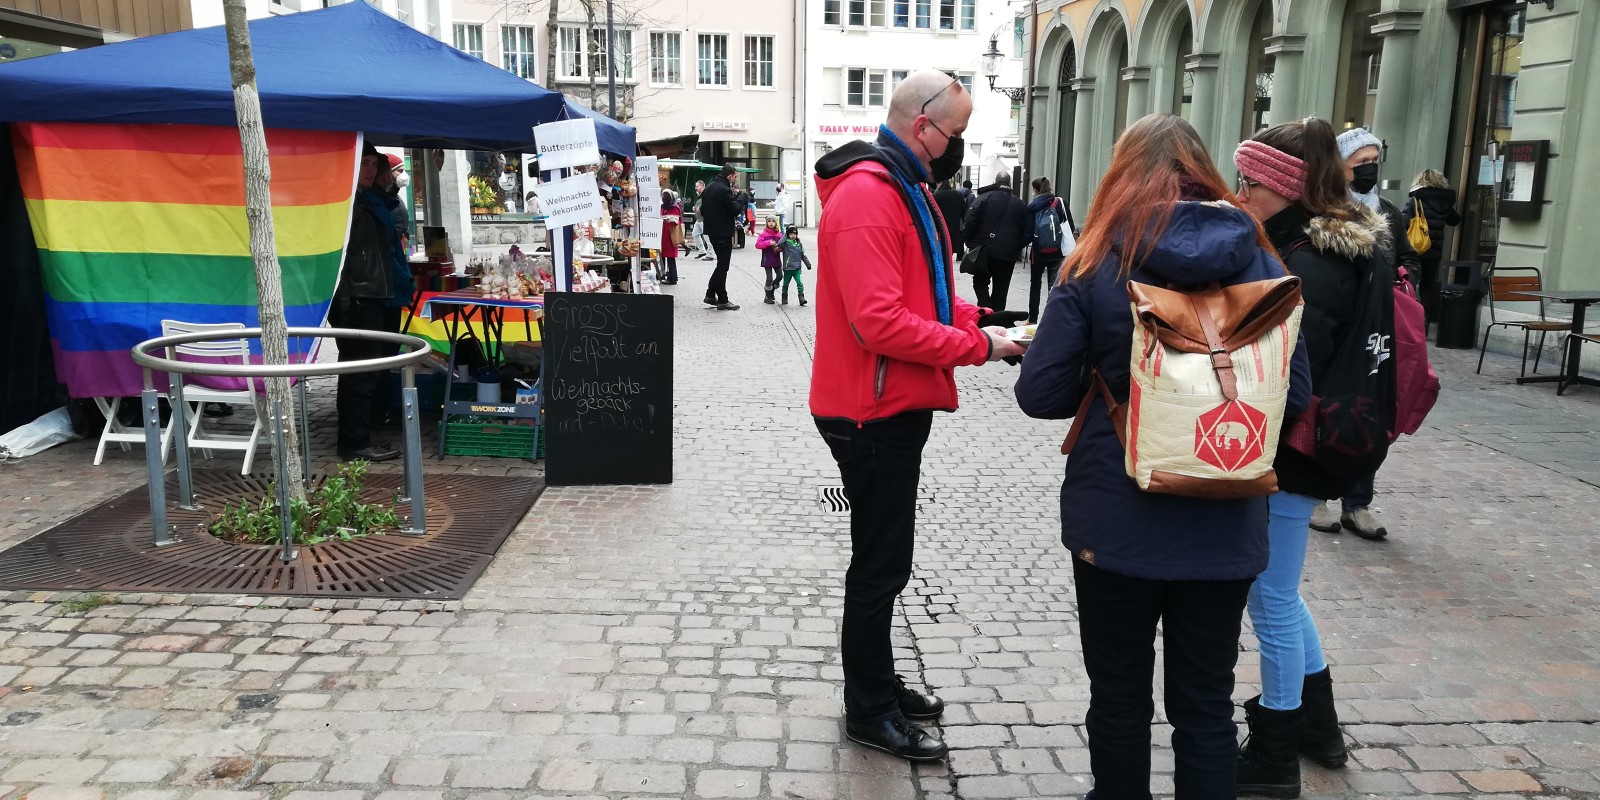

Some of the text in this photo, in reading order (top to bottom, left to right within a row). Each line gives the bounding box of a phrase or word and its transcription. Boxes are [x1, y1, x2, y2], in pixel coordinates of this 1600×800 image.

[703, 120, 750, 129] DEPOT
[819, 125, 849, 133] TALLY
[540, 139, 593, 153] Butterzöpfe
[545, 190, 593, 206] Weihnachts-
[552, 201, 593, 217] dekoration
[551, 298, 635, 335] Grosse
[551, 333, 660, 377] Vielfalt an
